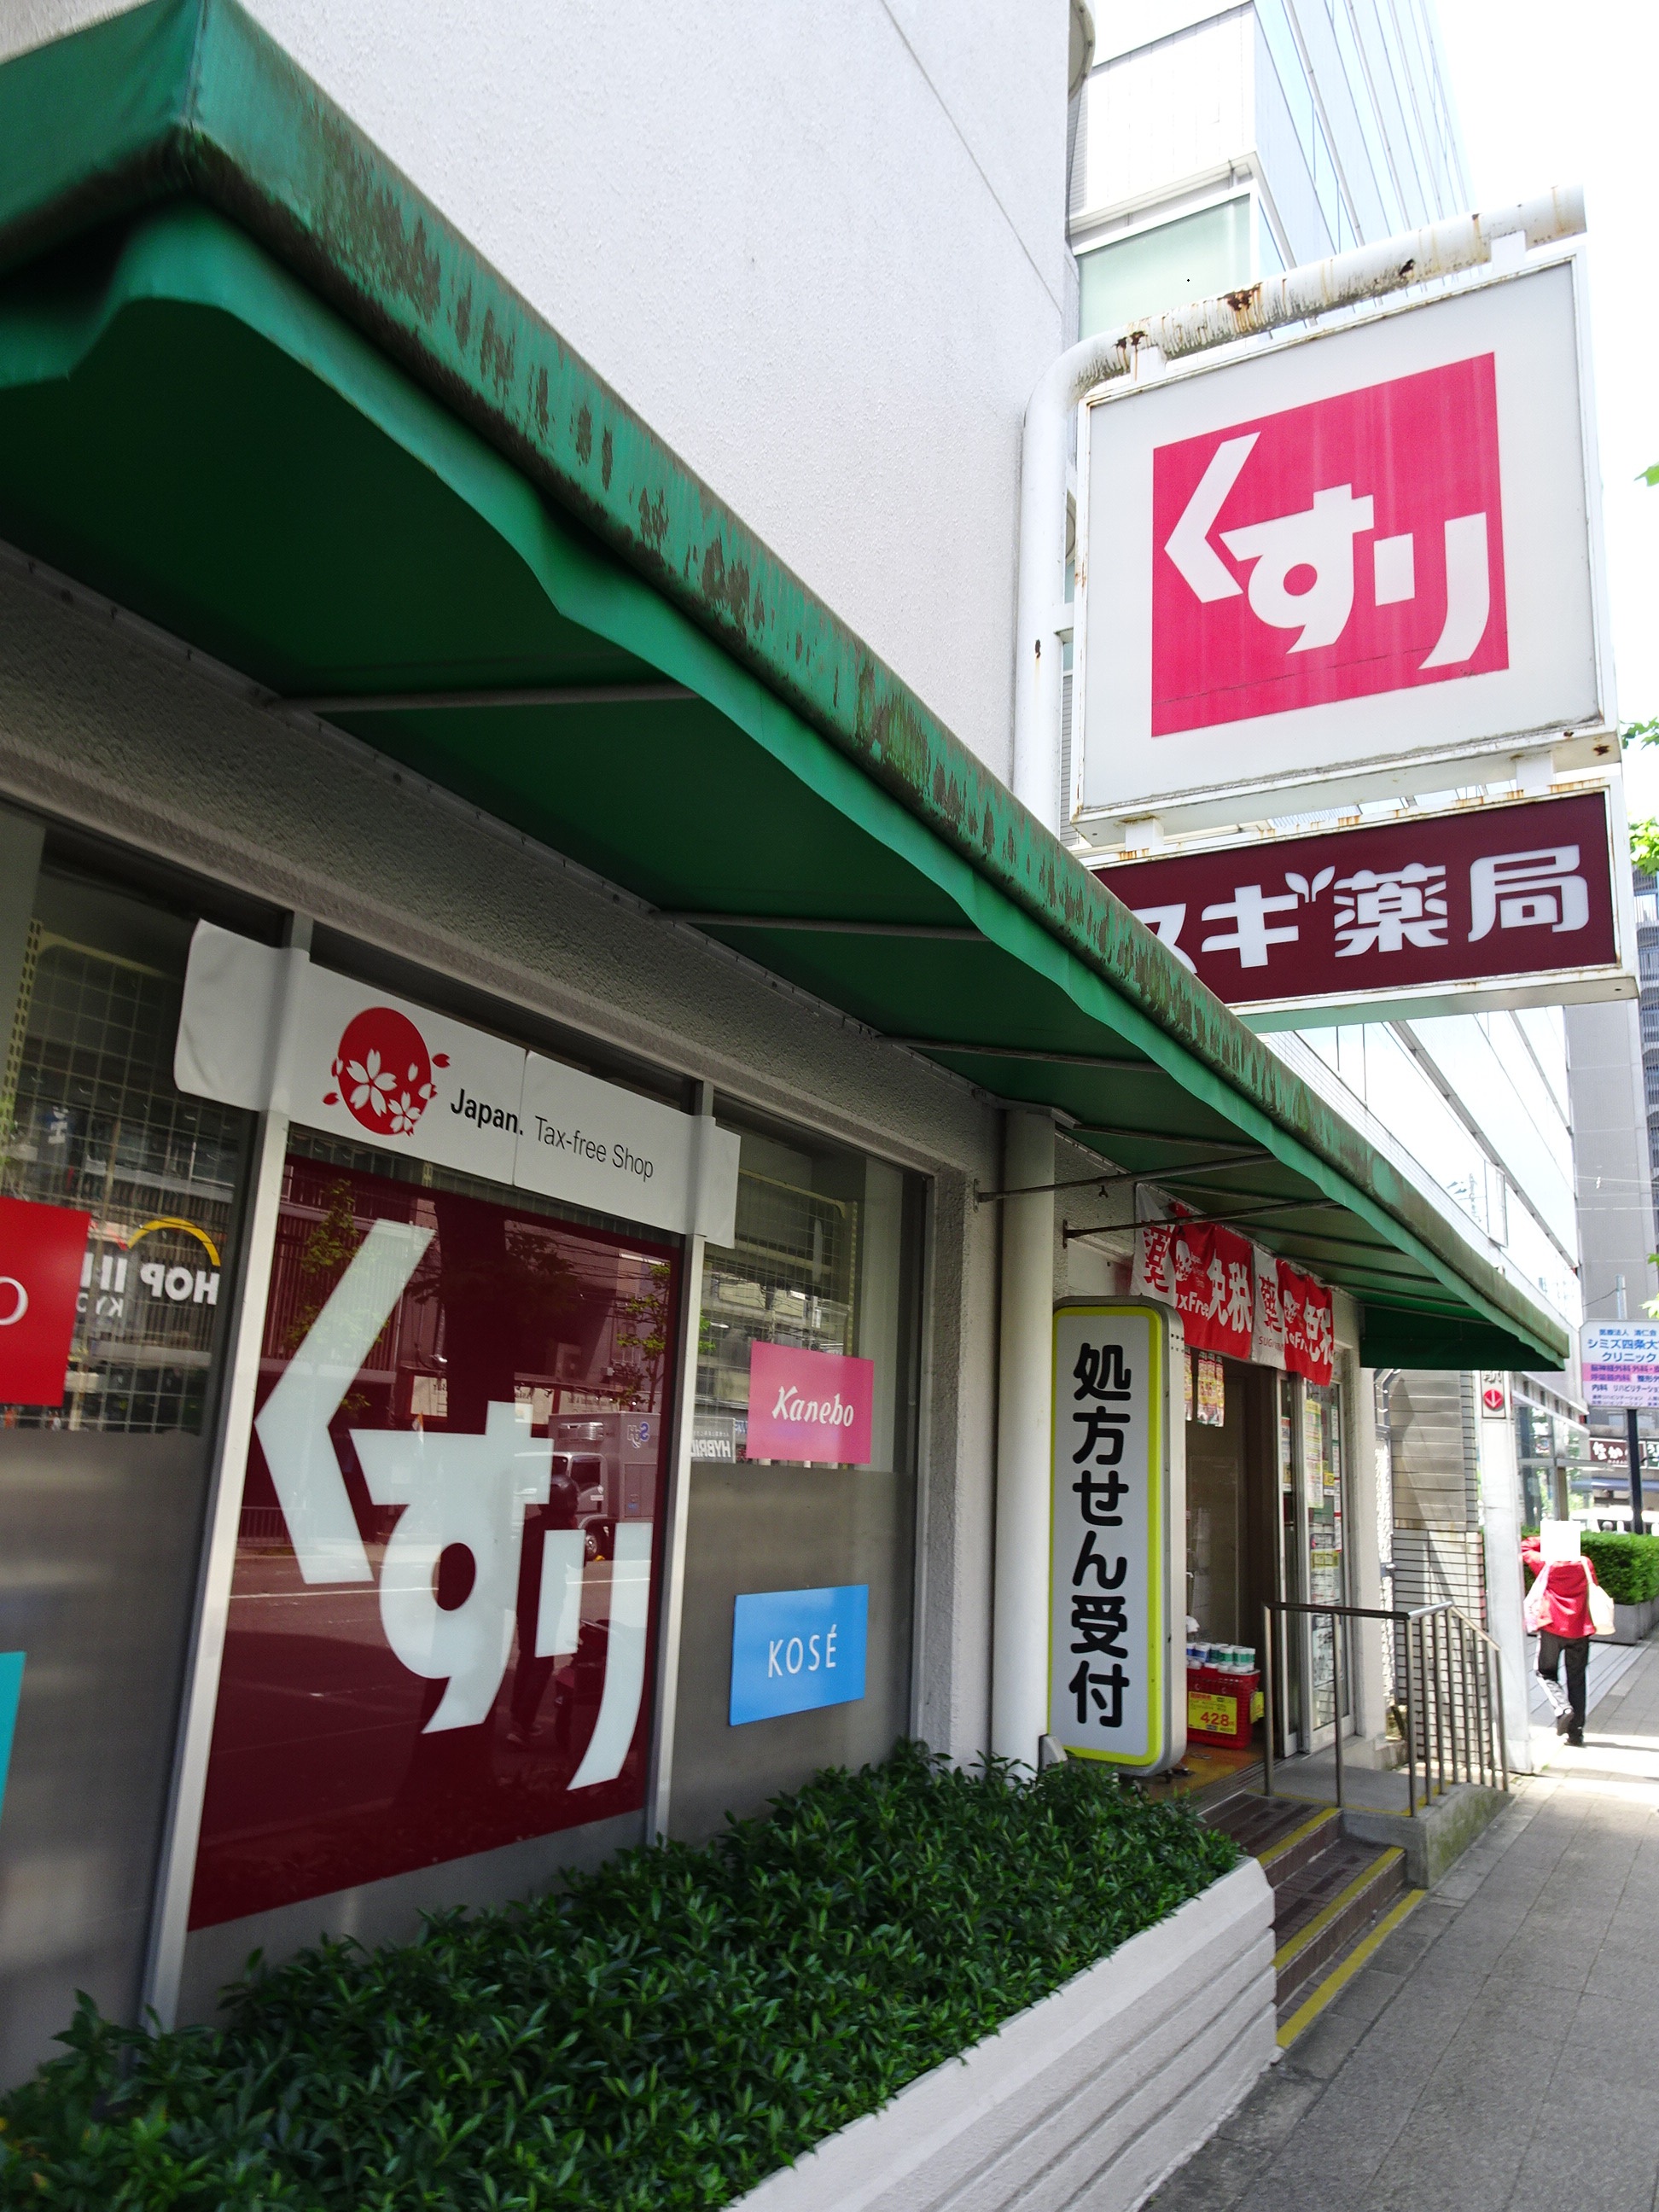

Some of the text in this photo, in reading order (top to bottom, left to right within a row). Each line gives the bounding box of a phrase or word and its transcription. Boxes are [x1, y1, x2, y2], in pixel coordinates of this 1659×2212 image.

[1164, 432, 1490, 670] くすり
[451, 1088, 654, 1183] Japan. Tax-free Shop
[1206, 1248, 1252, 1333] 免税
[1587, 1338, 1659, 1349] シミズ四条大
[1602, 1352, 1656, 1363] クリニック
[771, 1386, 854, 1427] Kanebo
[1592, 1441, 1628, 1460] なか
[254, 1218, 654, 1790] くすり
[1068, 1342, 1132, 1728] 処方せん受付
[768, 1624, 837, 1679] KOSÉ
[1201, 1712, 1230, 1727] 428
